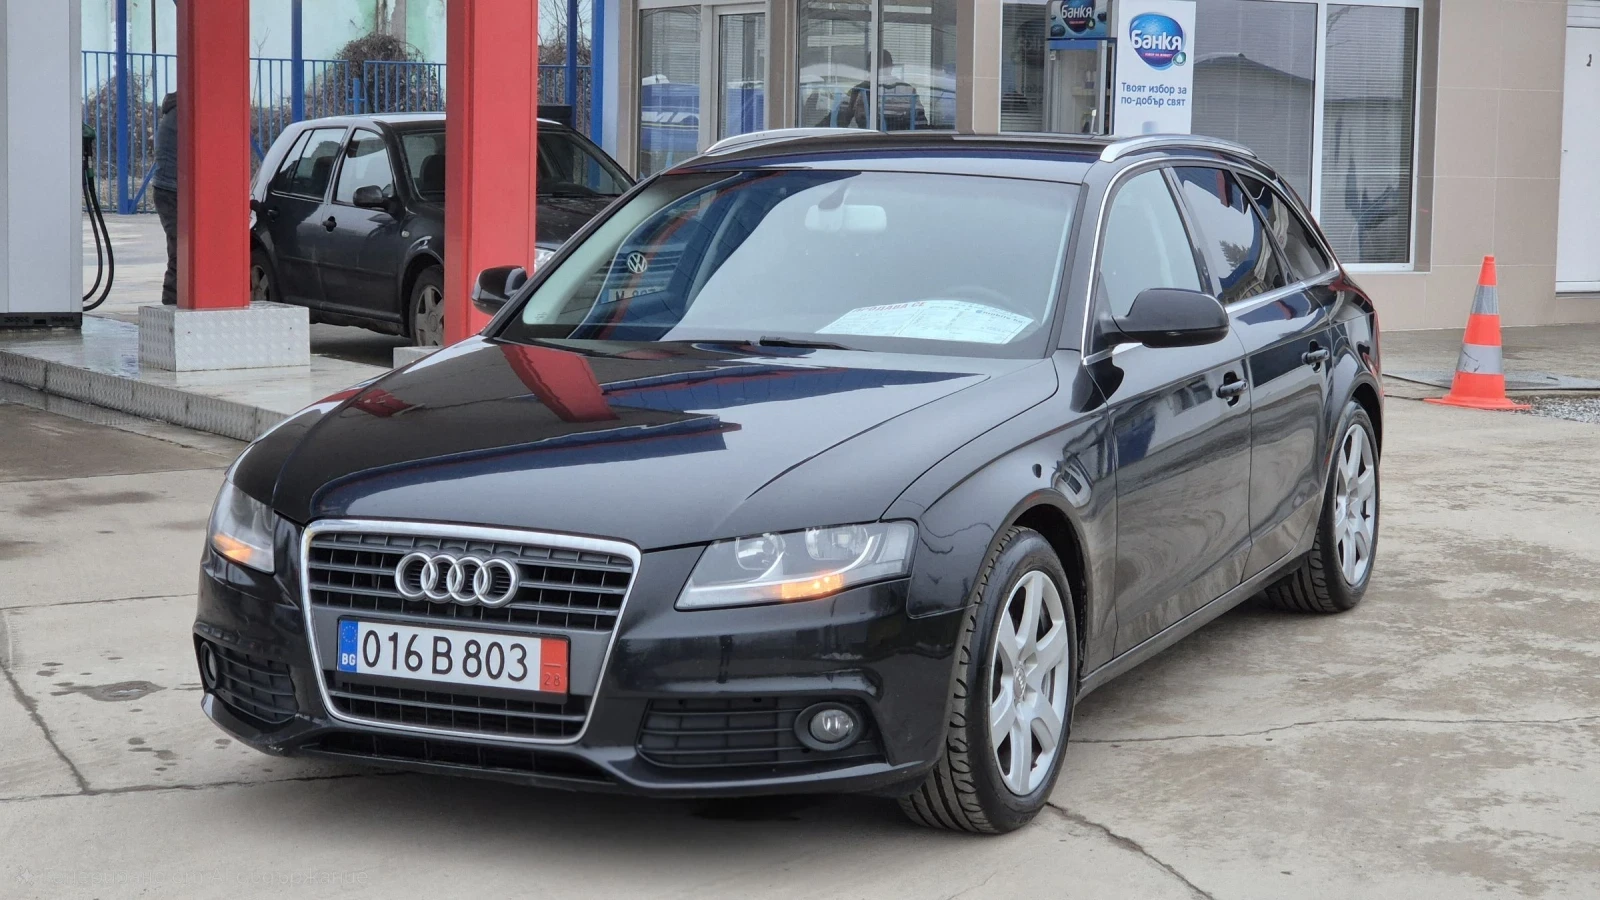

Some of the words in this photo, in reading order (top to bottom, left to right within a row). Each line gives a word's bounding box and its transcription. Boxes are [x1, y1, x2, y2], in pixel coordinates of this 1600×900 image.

[1121, 82, 1146, 92] Твоят
[1149, 84, 1175, 96] избор
[1177, 86, 1187, 94] за
[1121, 96, 1164, 108] по-добър
[1166, 98, 1186, 106] свят
[341, 653, 356, 666] BG
[544, 672, 561, 687] 28
